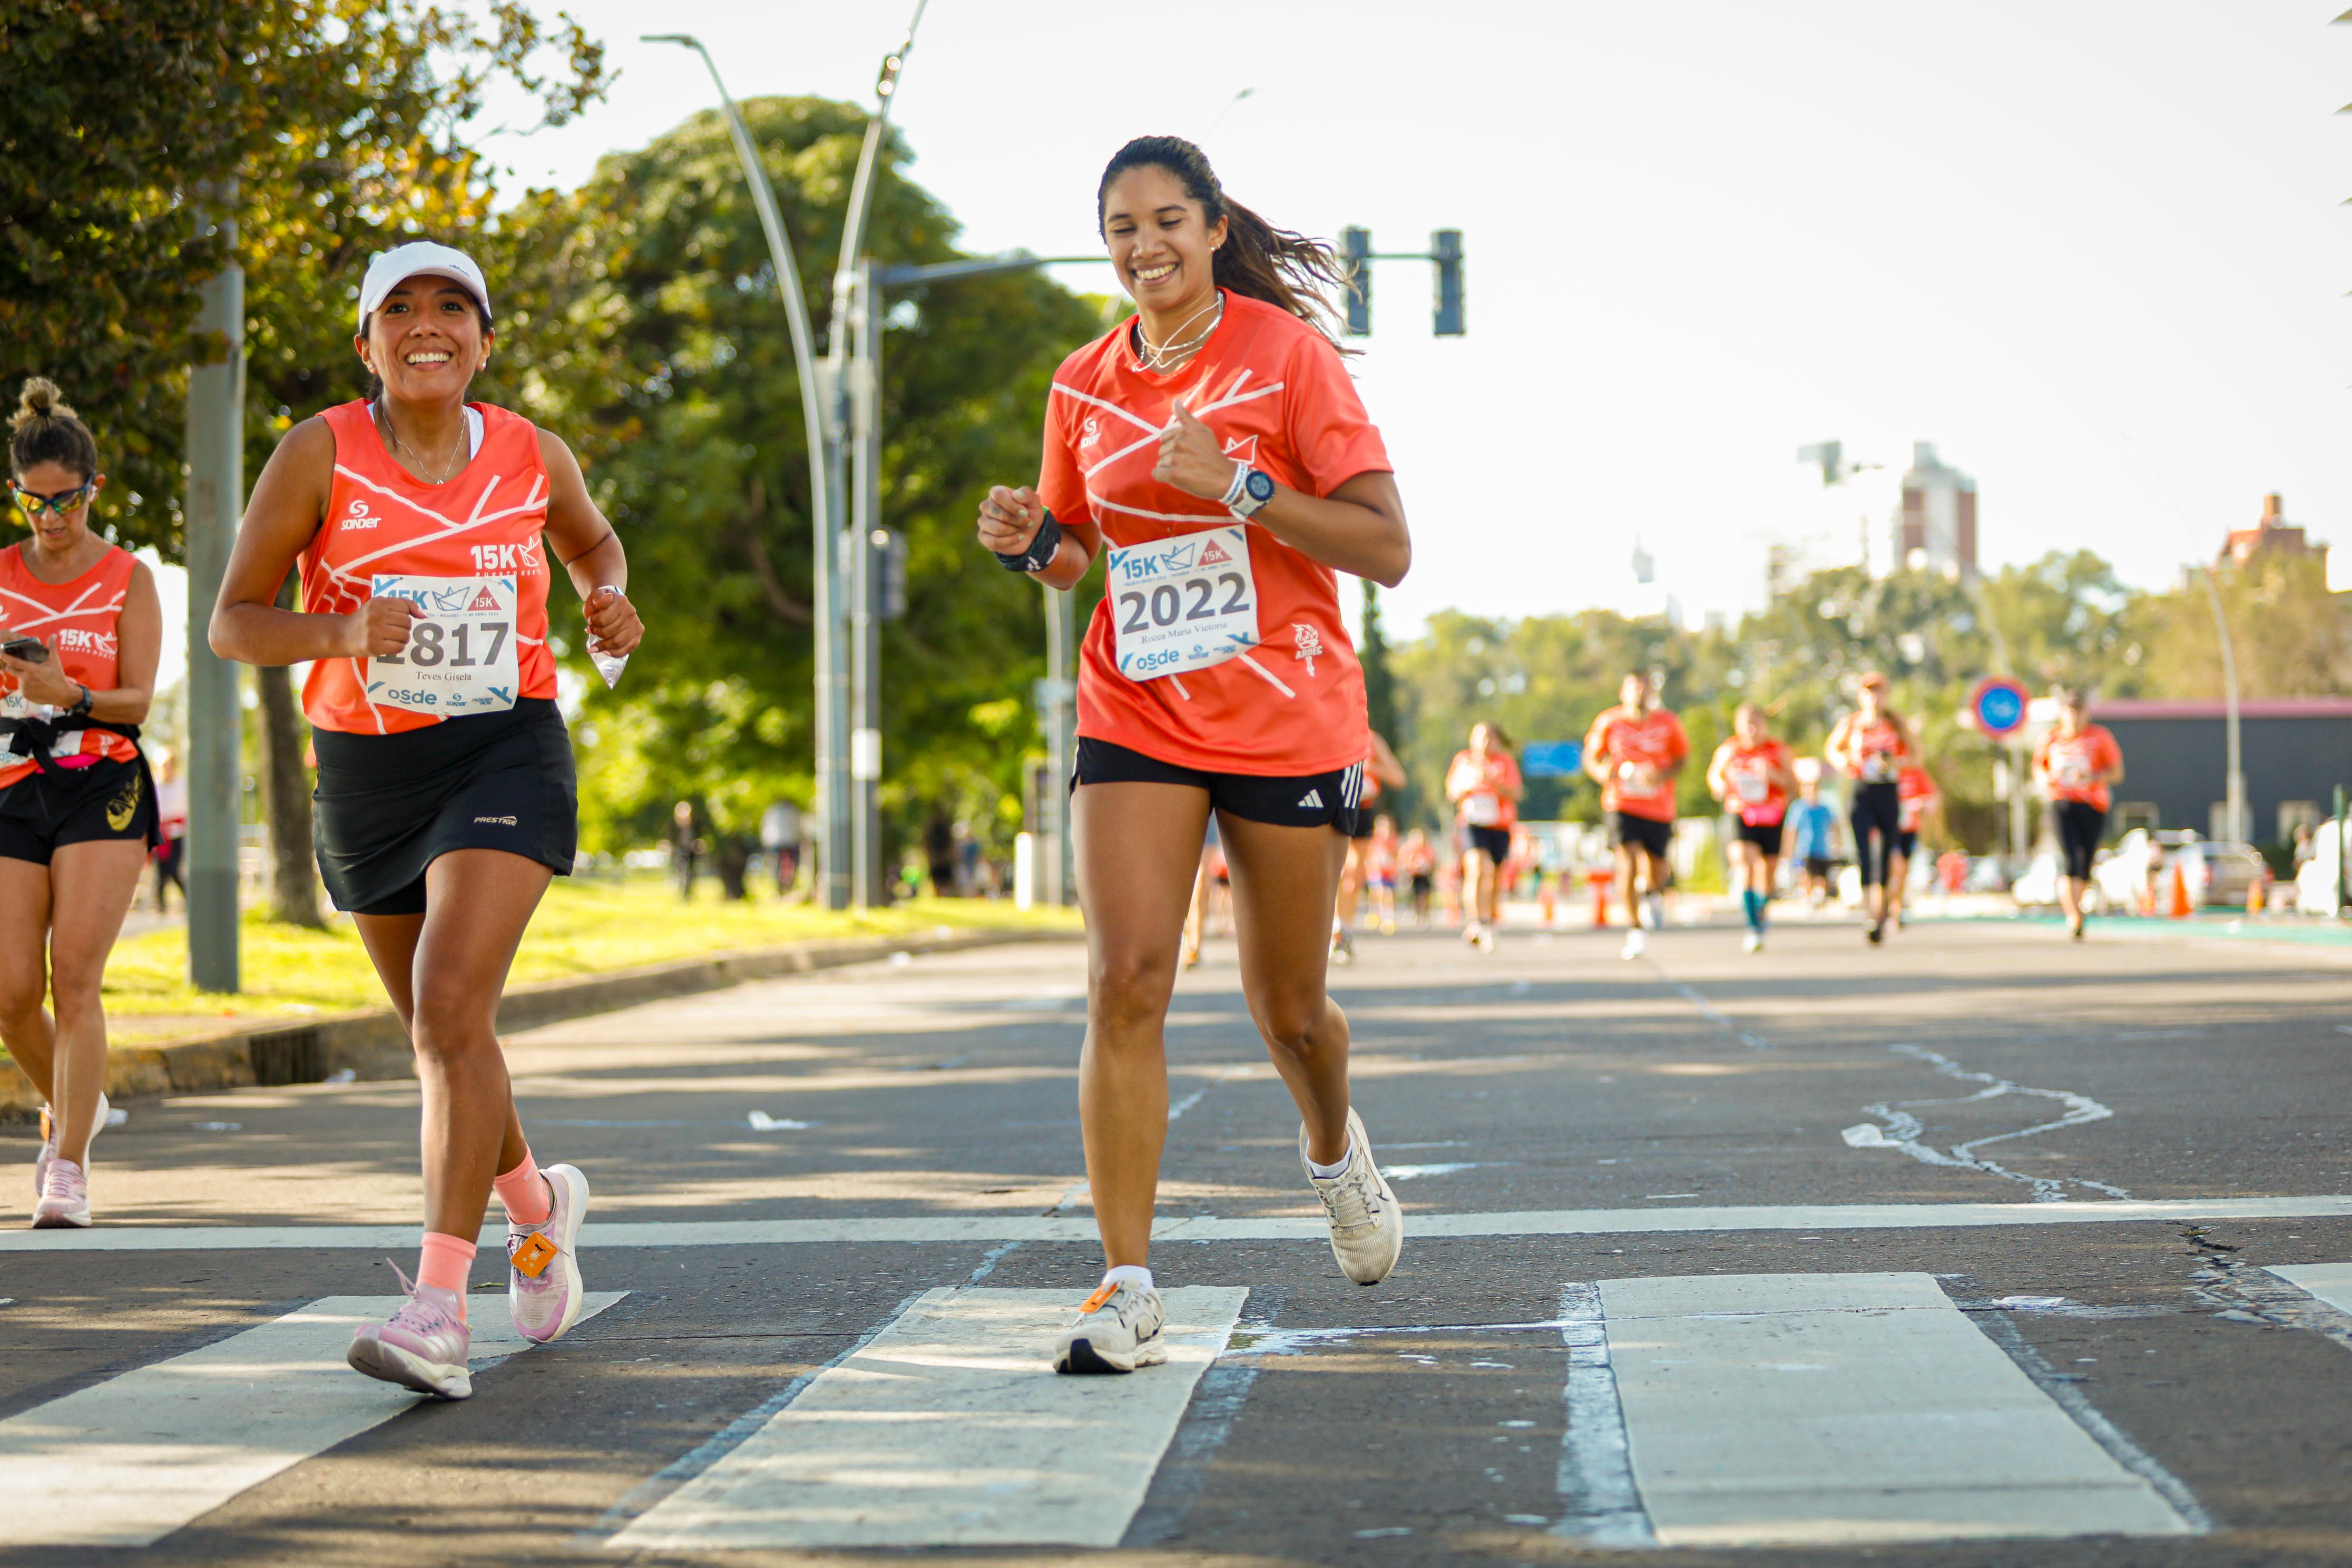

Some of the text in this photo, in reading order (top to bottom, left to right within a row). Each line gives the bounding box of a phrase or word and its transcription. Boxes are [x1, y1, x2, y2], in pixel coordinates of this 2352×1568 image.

[471, 544, 517, 570] 15K
[1204, 550, 1223, 561] 15K
[1123, 555, 1159, 580] 15K
[475, 597, 493, 607] 15K
[1120, 572, 1250, 635] 2022
[59, 629, 93, 648] 15K
[1142, 634, 1166, 644] Rocca
[1194, 622, 1228, 632] Victoria
[376, 622, 509, 667] 817
[1296, 645, 1323, 660] ARDEC
[1136, 649, 1180, 670] osde
[416, 671, 472, 681] Teves Gisela
[4, 695, 23, 708] 15K
[388, 689, 437, 705] osde
[474, 817, 517, 826] PRESTIGE
